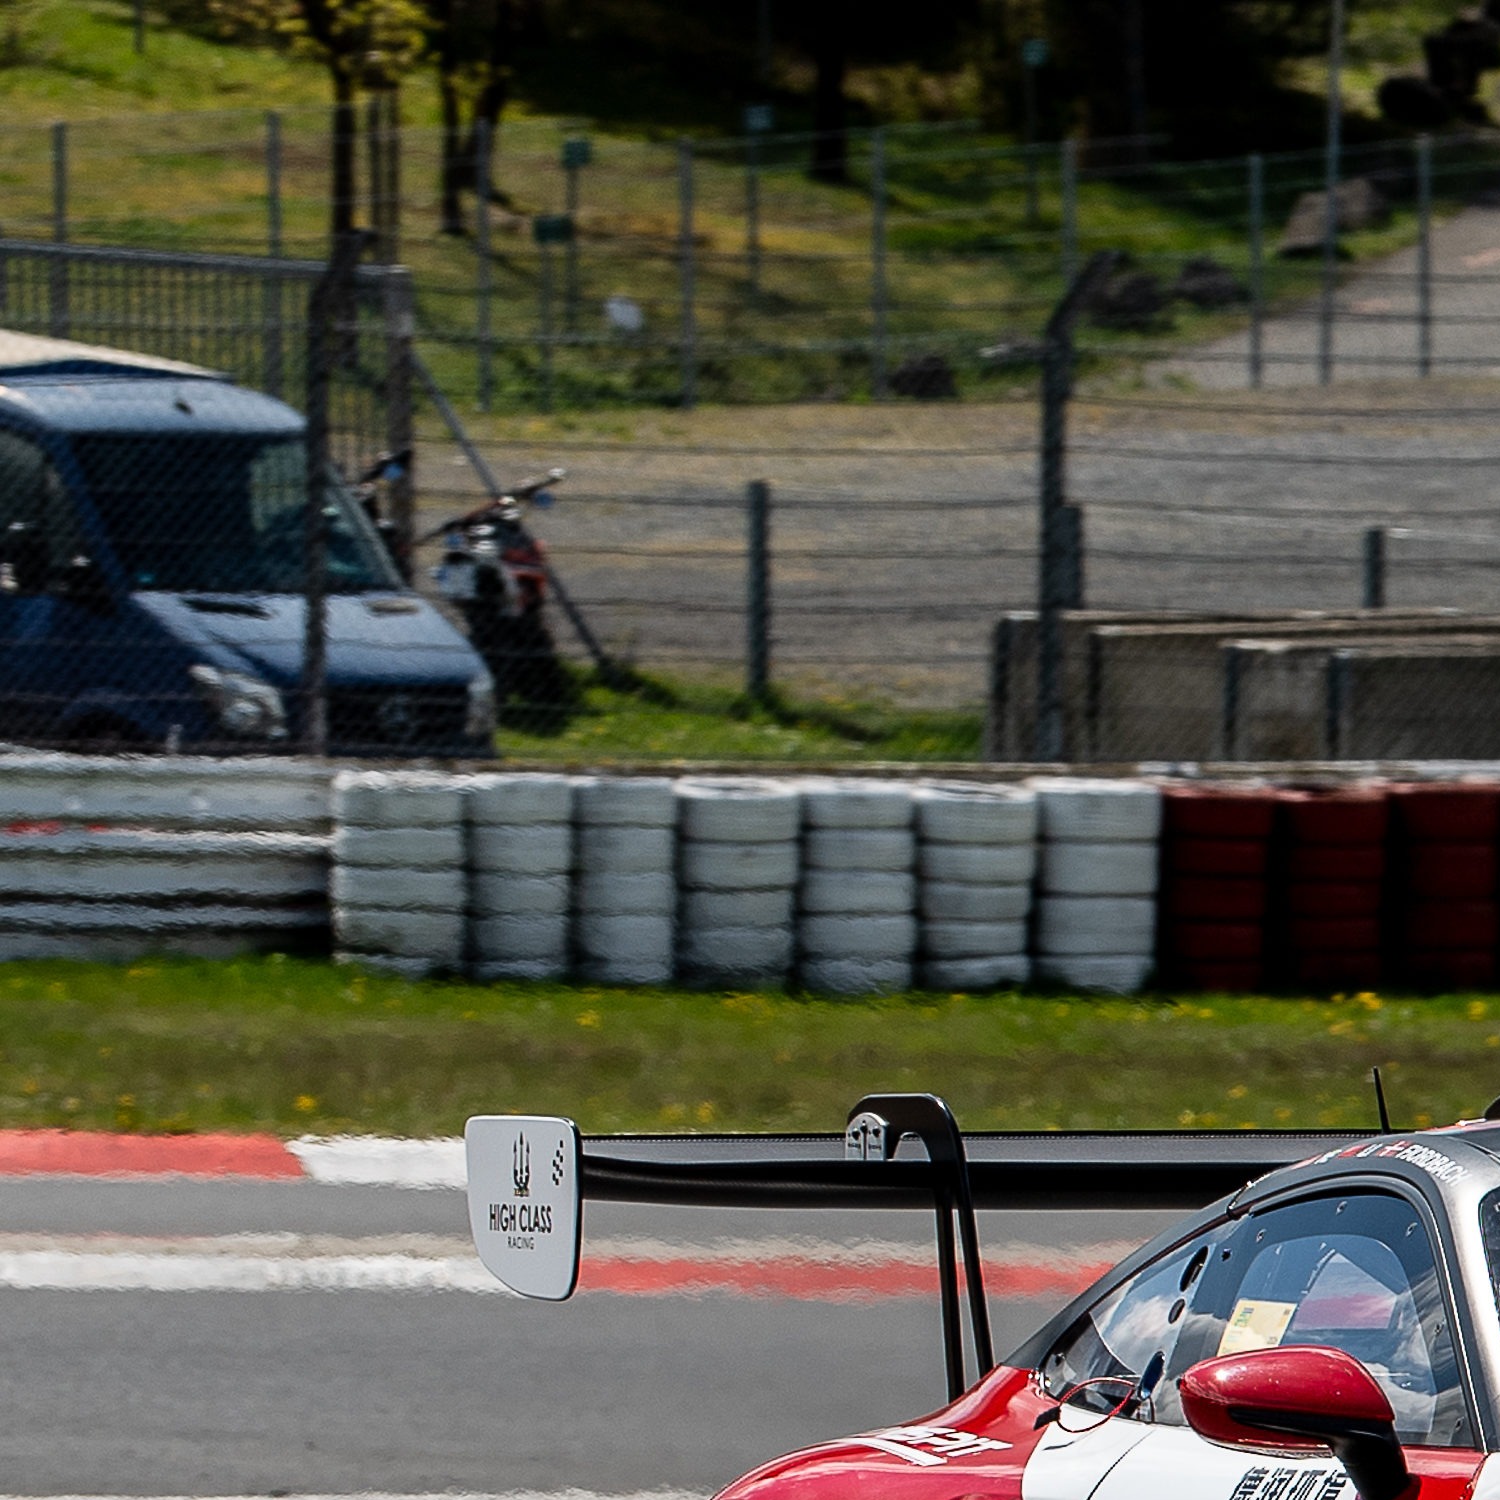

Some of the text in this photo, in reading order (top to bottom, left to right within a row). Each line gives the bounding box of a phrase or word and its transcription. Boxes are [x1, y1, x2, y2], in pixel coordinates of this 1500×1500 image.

[489, 1203, 552, 1234] HIGH CLASS
[507, 1236, 535, 1250] RACING
